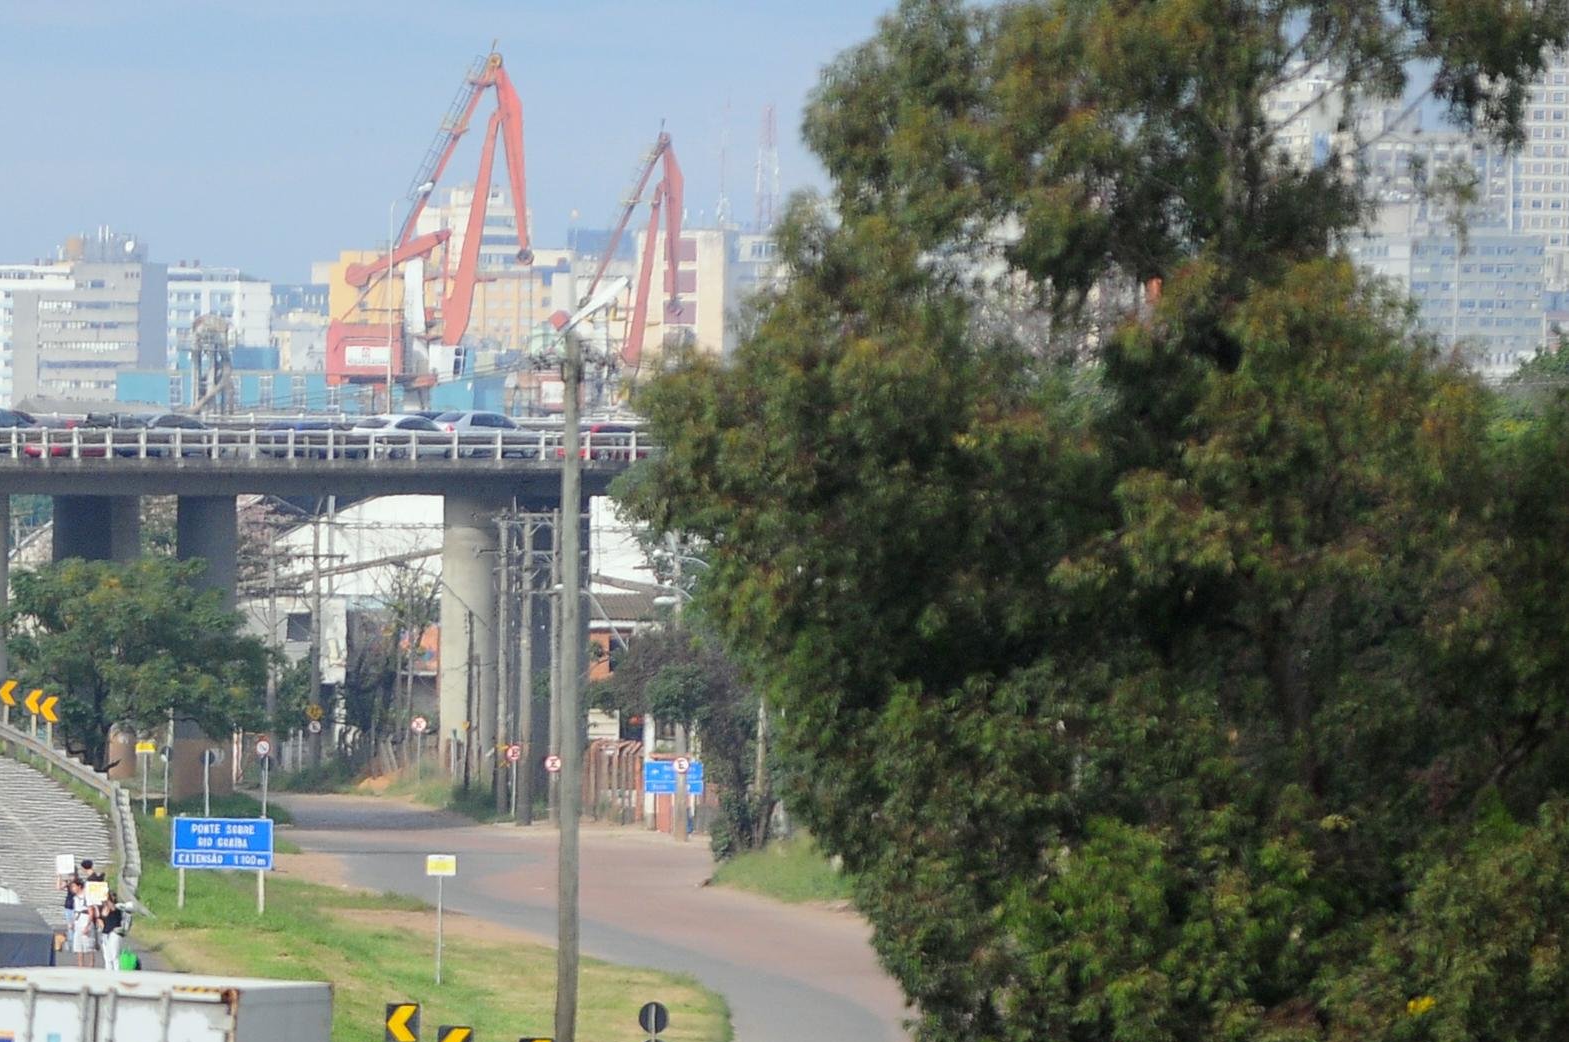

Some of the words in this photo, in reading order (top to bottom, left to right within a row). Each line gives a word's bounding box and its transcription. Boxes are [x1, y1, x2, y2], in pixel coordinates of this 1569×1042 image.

[191, 823, 221, 834] PONTE
[226, 824, 255, 835] SOBRE
[178, 853, 223, 864] EXTENSÃO
